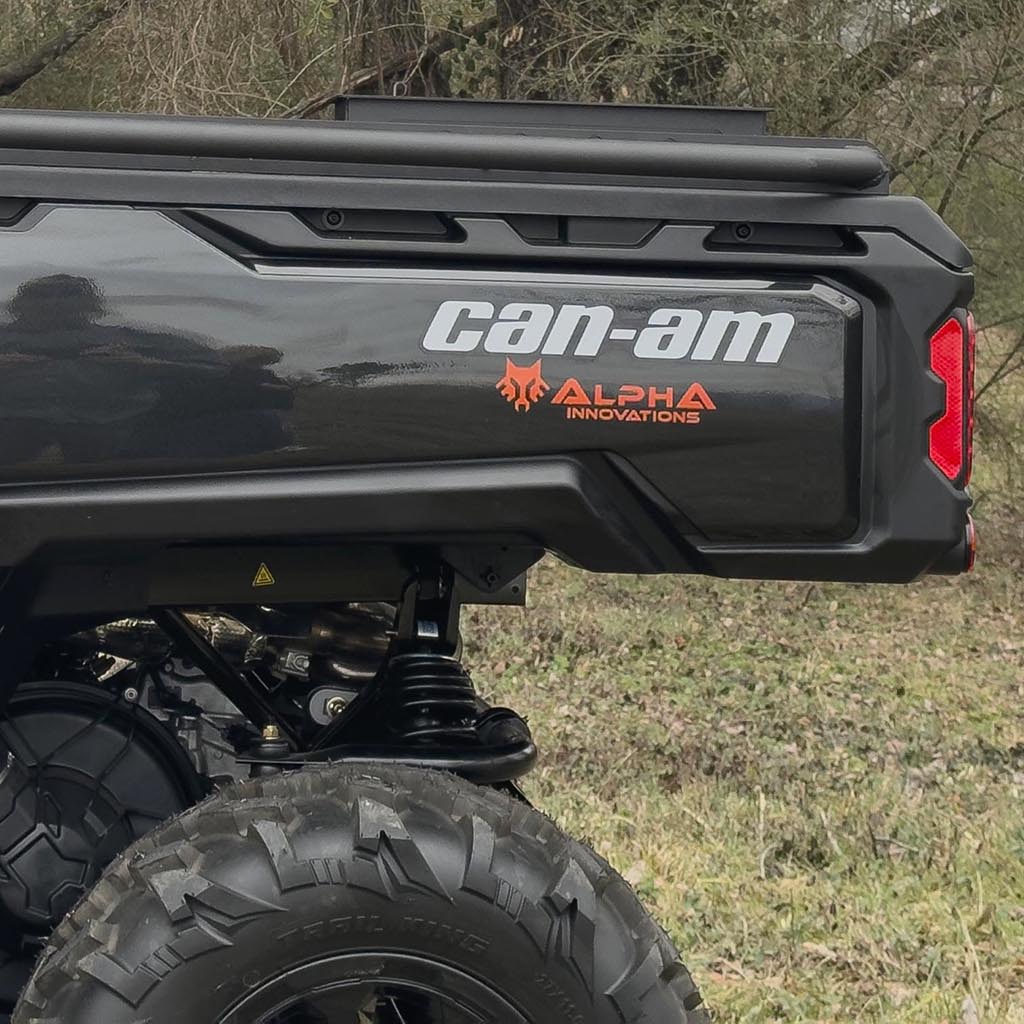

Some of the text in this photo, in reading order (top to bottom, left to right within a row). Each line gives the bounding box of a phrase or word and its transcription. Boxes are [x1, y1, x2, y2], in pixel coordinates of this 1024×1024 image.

[422, 301, 795, 363] can-am
[550, 378, 716, 410] ALPHA
[566, 407, 700, 424] INNOVATIONS
